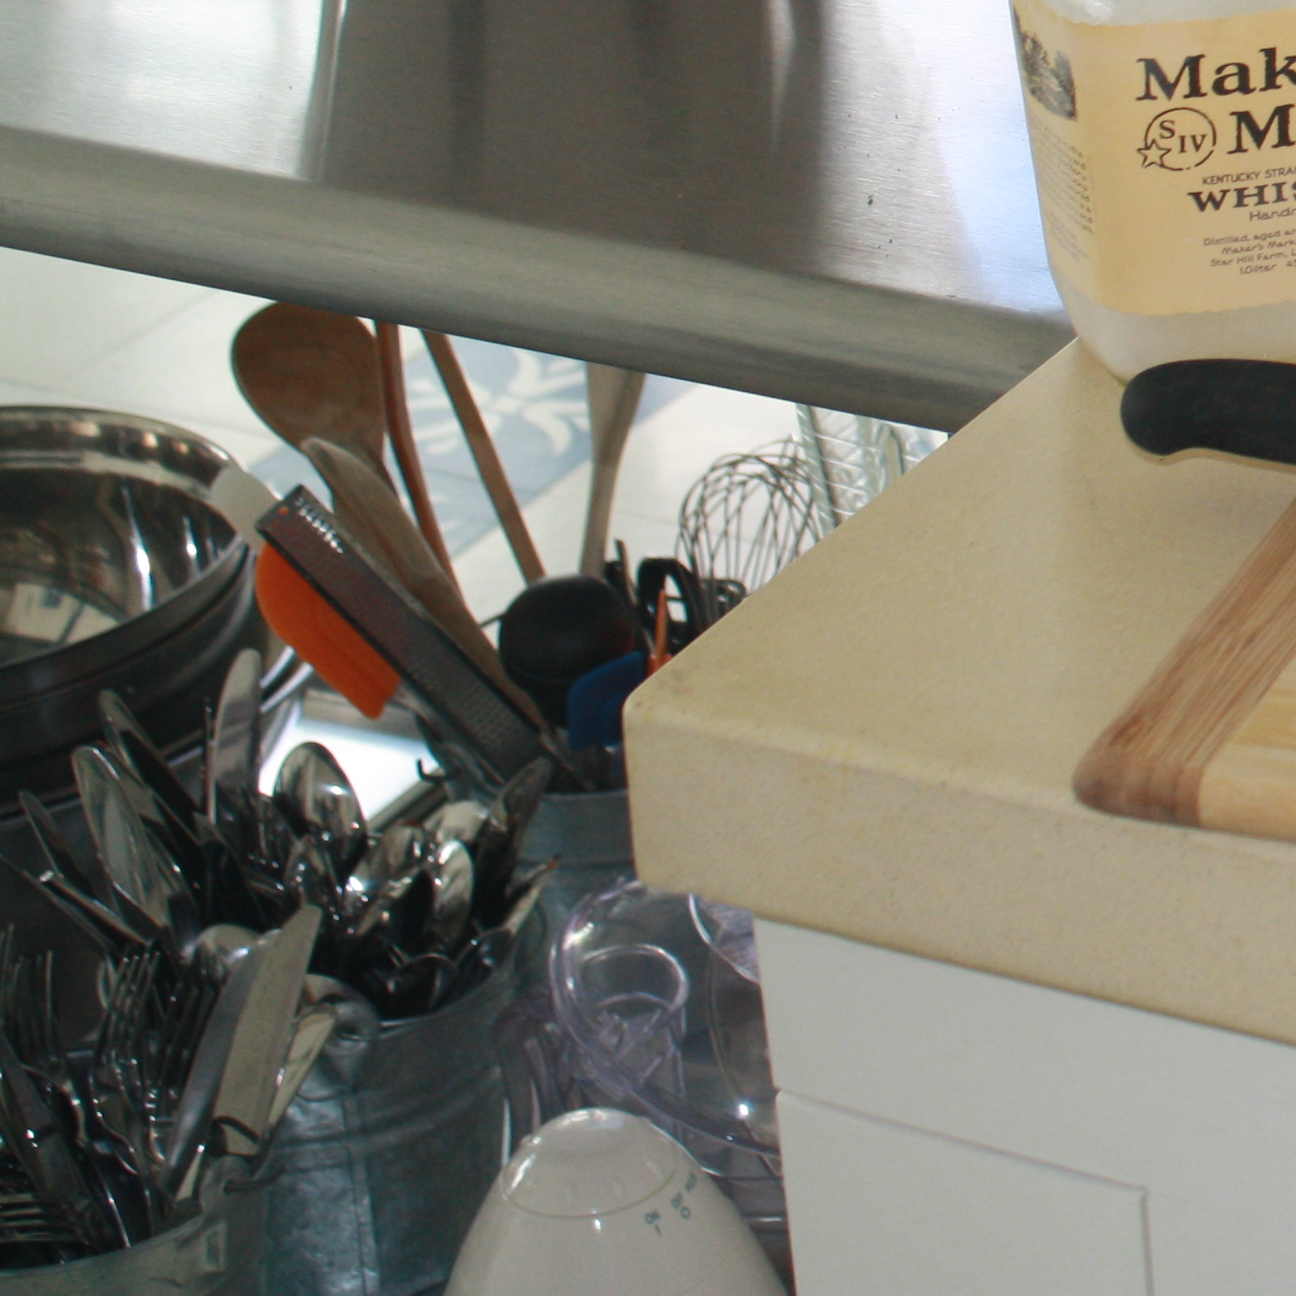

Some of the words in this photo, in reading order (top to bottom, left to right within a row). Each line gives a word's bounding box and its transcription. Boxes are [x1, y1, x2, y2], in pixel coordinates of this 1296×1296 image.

[1202, 171, 1261, 186] KENTUCKY
[1253, 230, 1281, 242] aged
[1221, 243, 1264, 255] Maker's
[1210, 257, 1233, 267] Star
[1237, 255, 1254, 265] Hill
